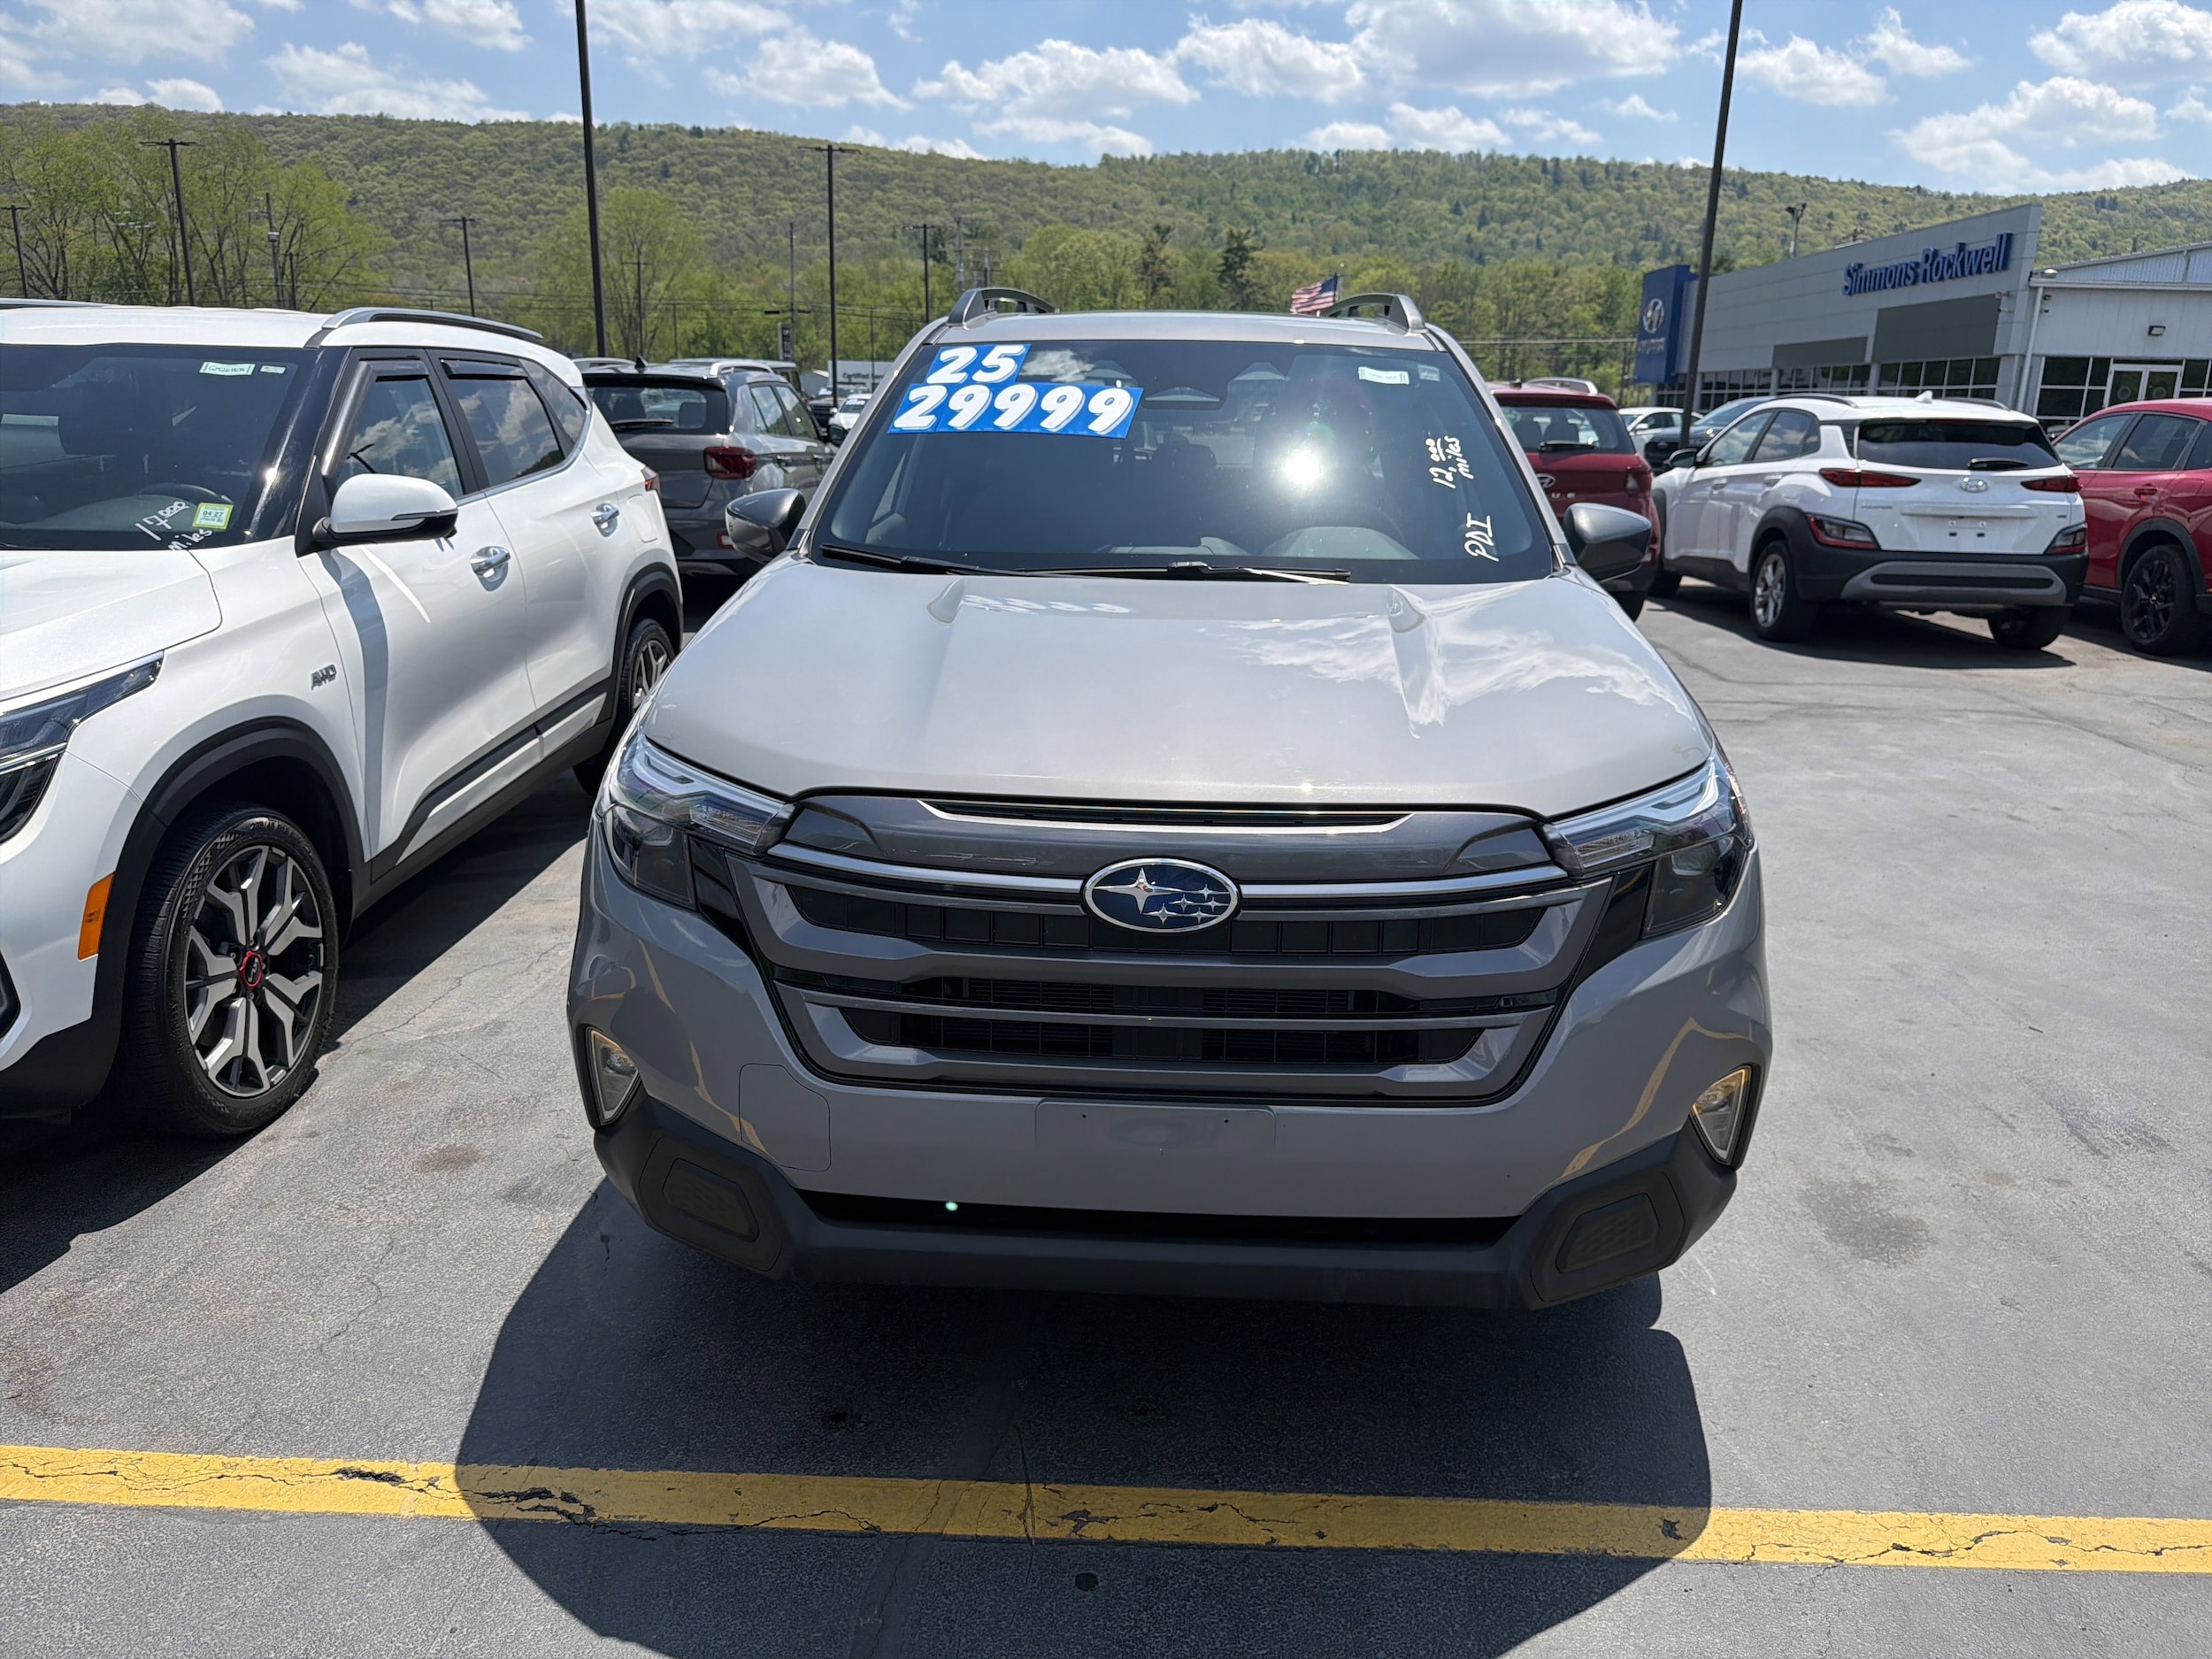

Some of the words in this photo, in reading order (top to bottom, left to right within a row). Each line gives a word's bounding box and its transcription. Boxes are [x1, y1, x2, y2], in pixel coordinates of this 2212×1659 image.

[1842, 262, 1921, 296] Simmons
[1919, 233, 2013, 283] Rockwell
[926, 344, 1027, 383] 25
[893, 384, 1134, 435] 29999
[1444, 435, 1474, 480] miles
[311, 664, 337, 690] AWD
